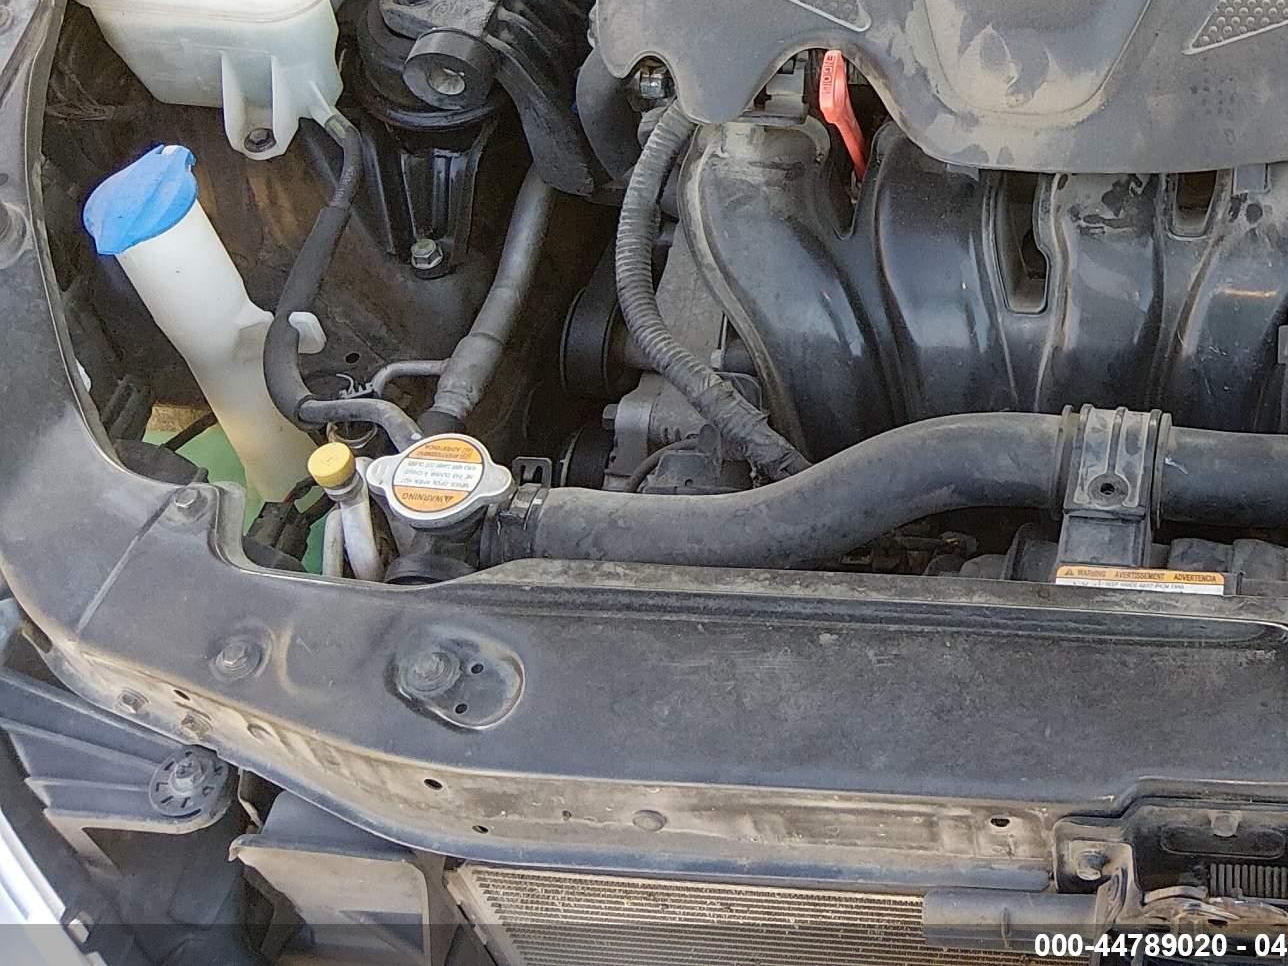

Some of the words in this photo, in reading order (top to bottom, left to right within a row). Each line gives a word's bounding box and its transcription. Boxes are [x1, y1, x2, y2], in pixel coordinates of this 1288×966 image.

[401, 491, 444, 503] WARNING
[1114, 570, 1165, 580] AVERTISSEMENT
[1173, 573, 1217, 582] ADVERTENCIA
